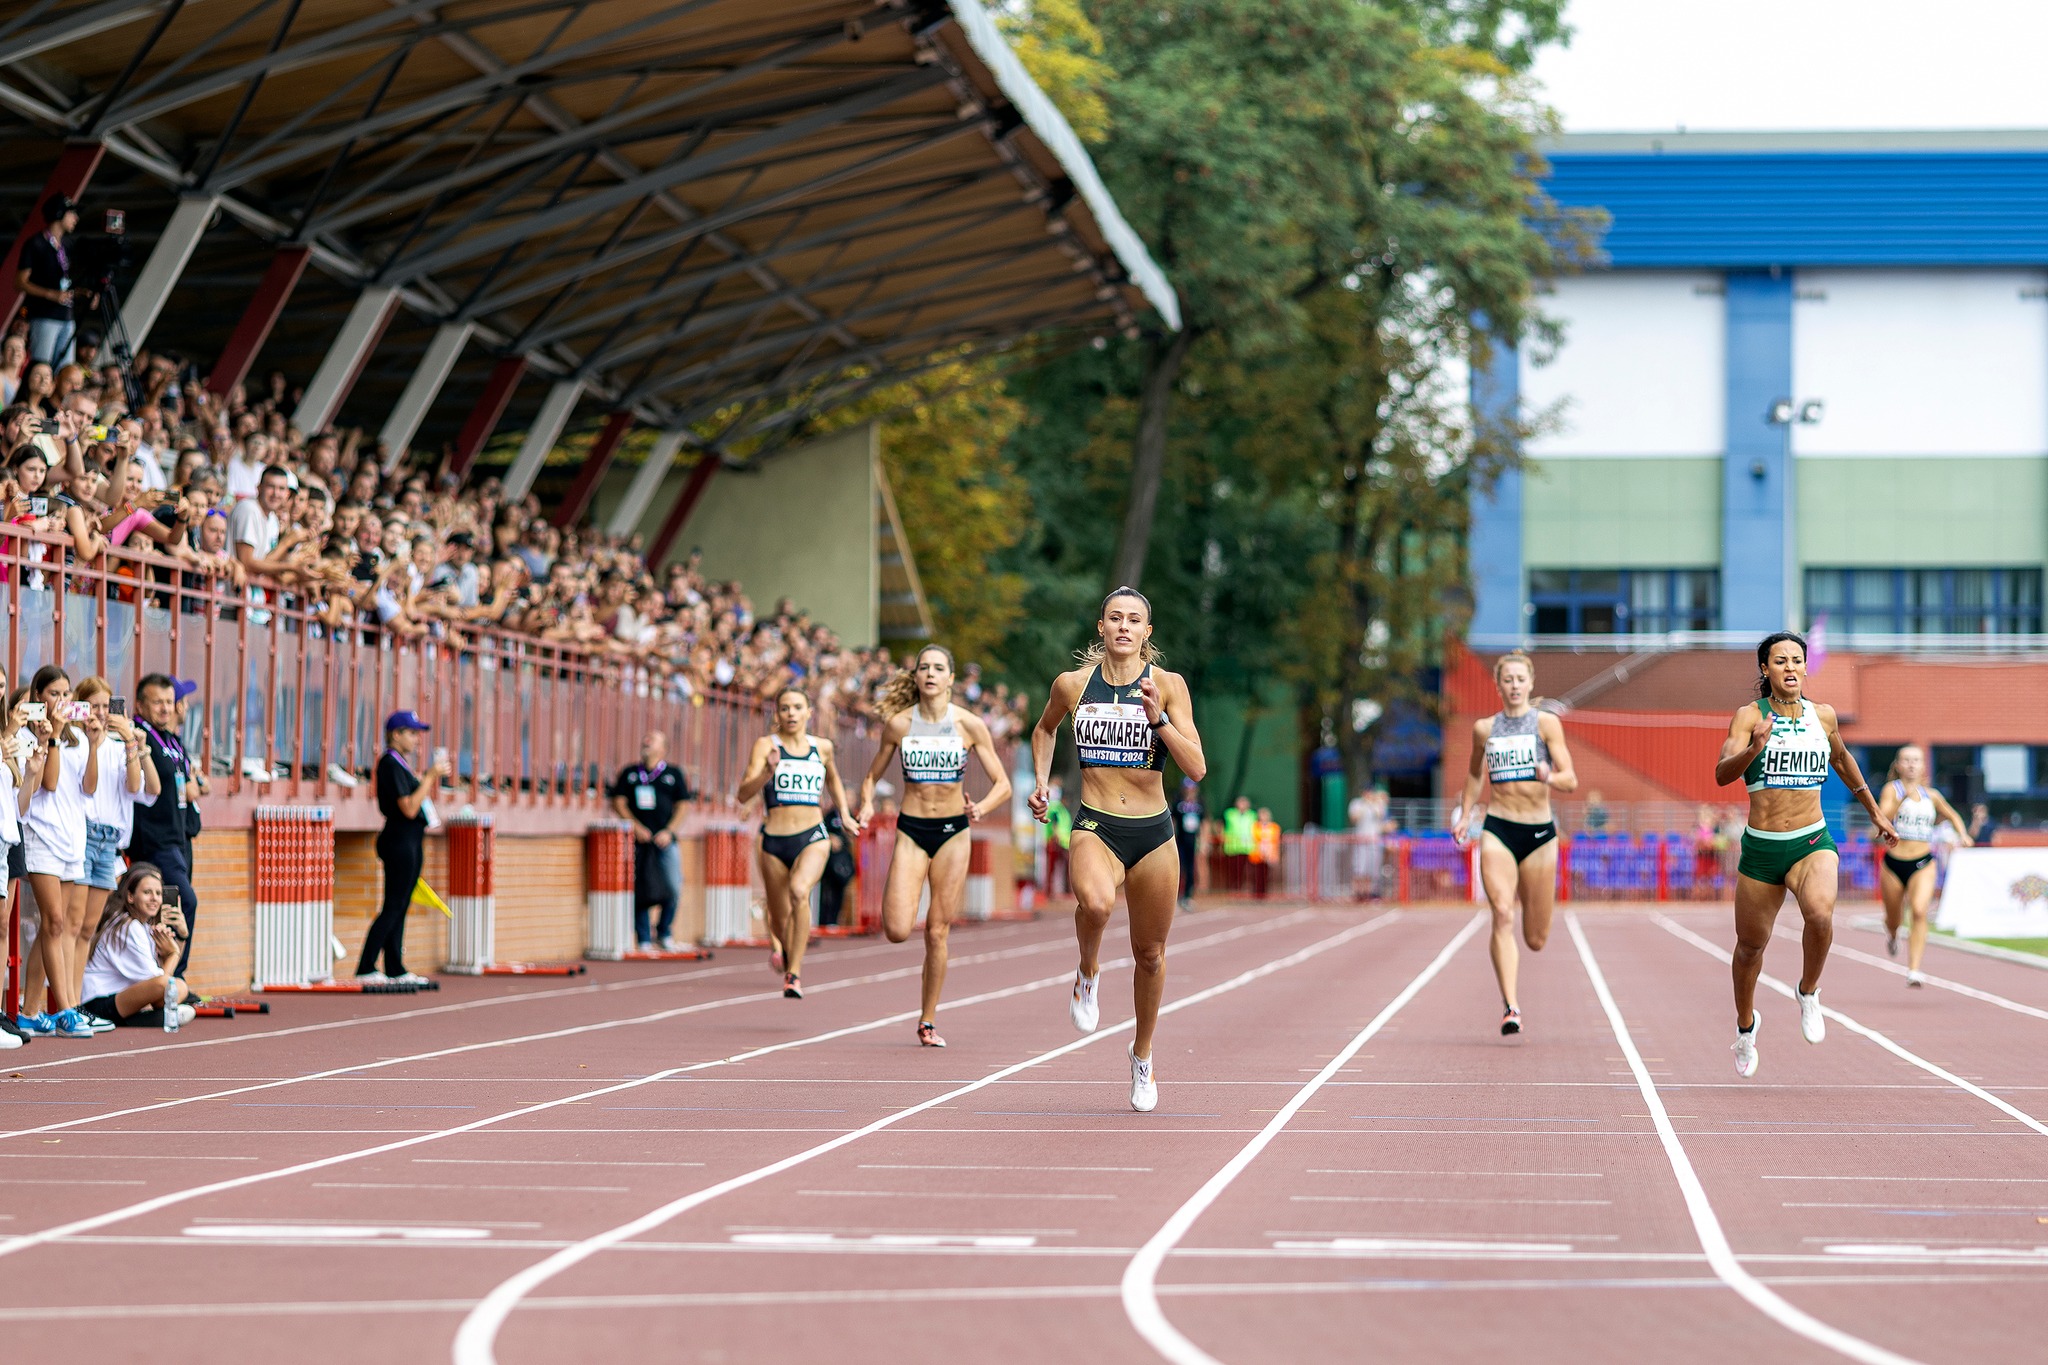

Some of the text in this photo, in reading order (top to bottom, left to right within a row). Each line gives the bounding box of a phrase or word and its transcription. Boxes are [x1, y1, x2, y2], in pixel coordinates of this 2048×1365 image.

[1075, 720, 1150, 748] KACZMAREK
[903, 750, 959, 768] ŁOZOWSKA
[1080, 748, 1144, 762] BIAŁYSTOK 2024
[1766, 750, 1826, 773] HEMIDA
[777, 773, 822, 791] GRYC
